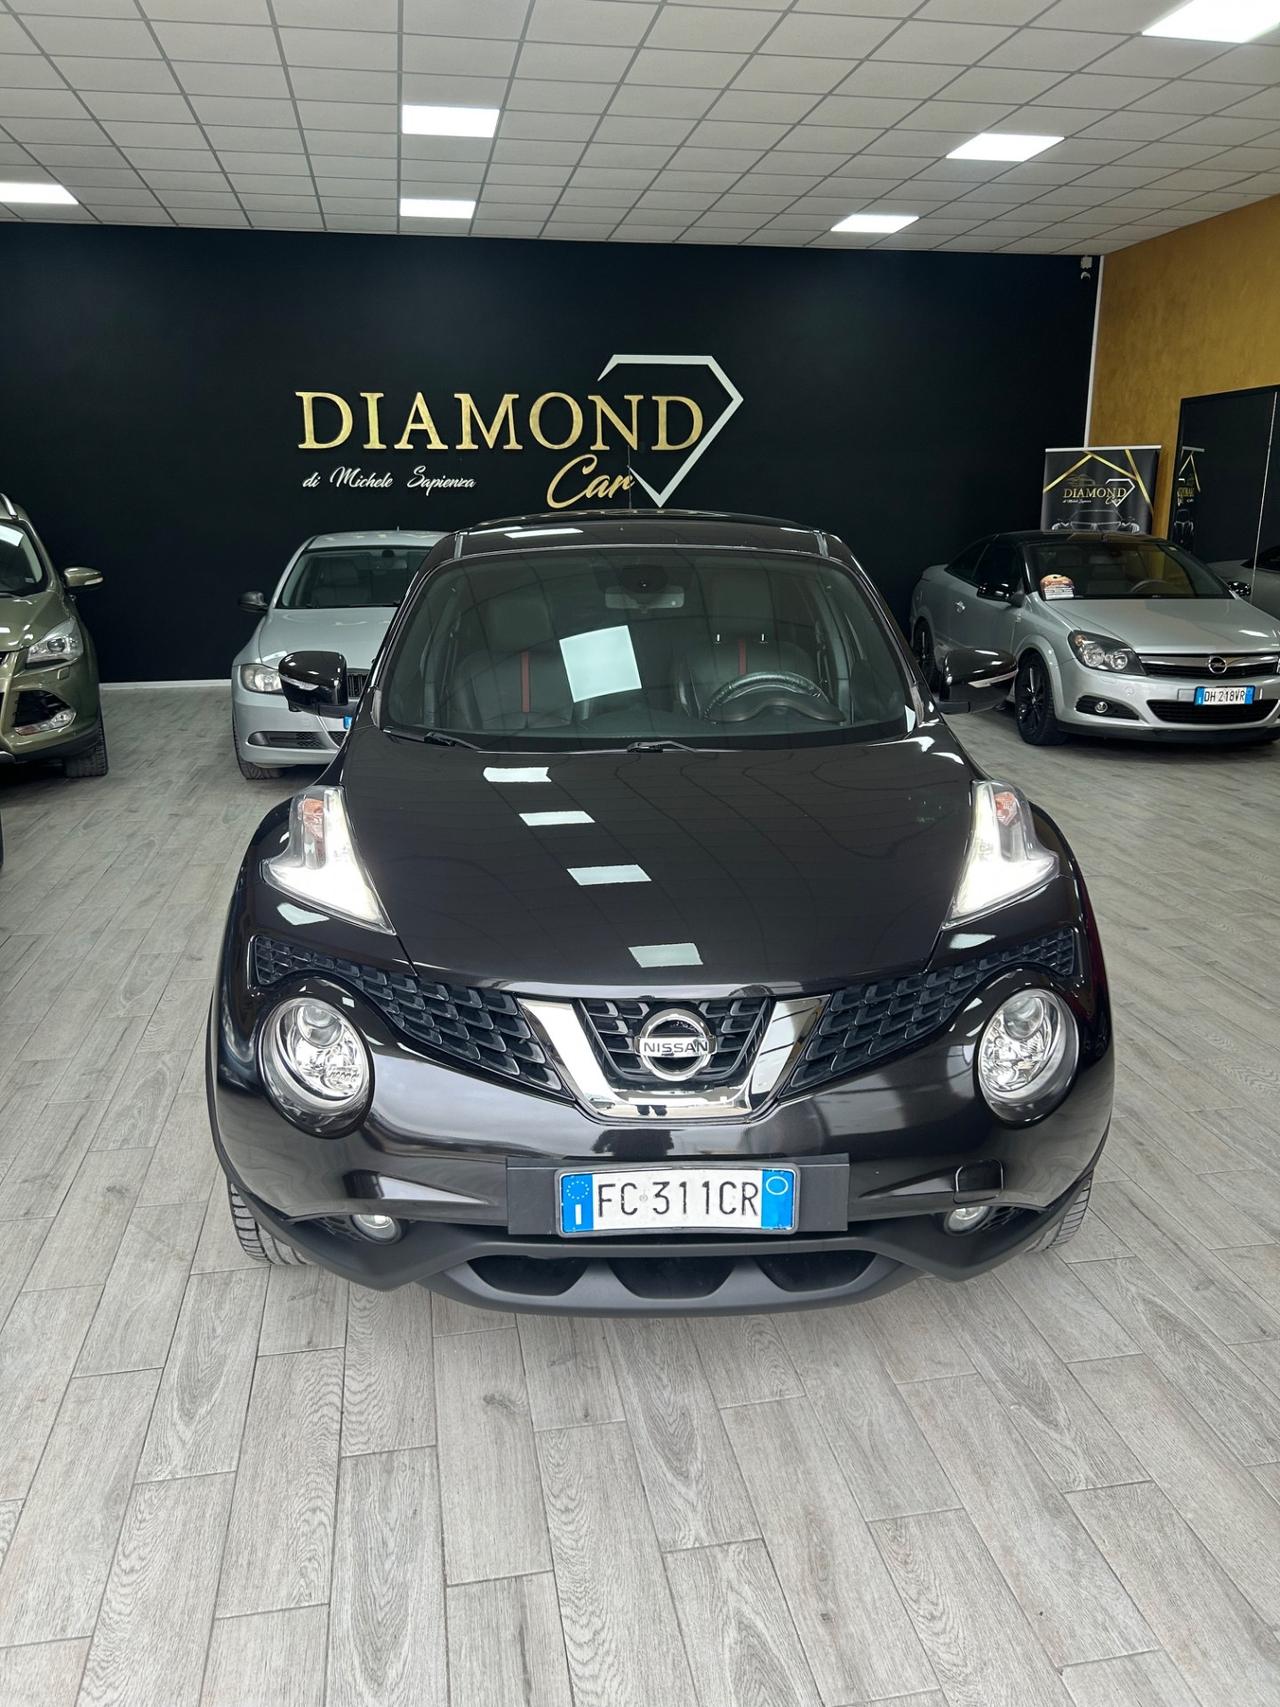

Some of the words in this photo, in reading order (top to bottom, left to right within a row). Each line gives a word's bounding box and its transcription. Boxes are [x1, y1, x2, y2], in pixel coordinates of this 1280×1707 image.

[295, 391, 704, 451] DIAMOND
[302, 468, 321, 489] di
[329, 466, 394, 489] Michele
[406, 465, 477, 496] Sapienza
[546, 453, 635, 509] Car
[1063, 488, 1126, 498] DIAMOND
[1204, 691, 1216, 703] DH
[1218, 690, 1245, 702] 218VR
[643, 1040, 708, 1054] NISSAN
[597, 1181, 639, 1217] FC
[652, 1180, 759, 1217] 311CR
